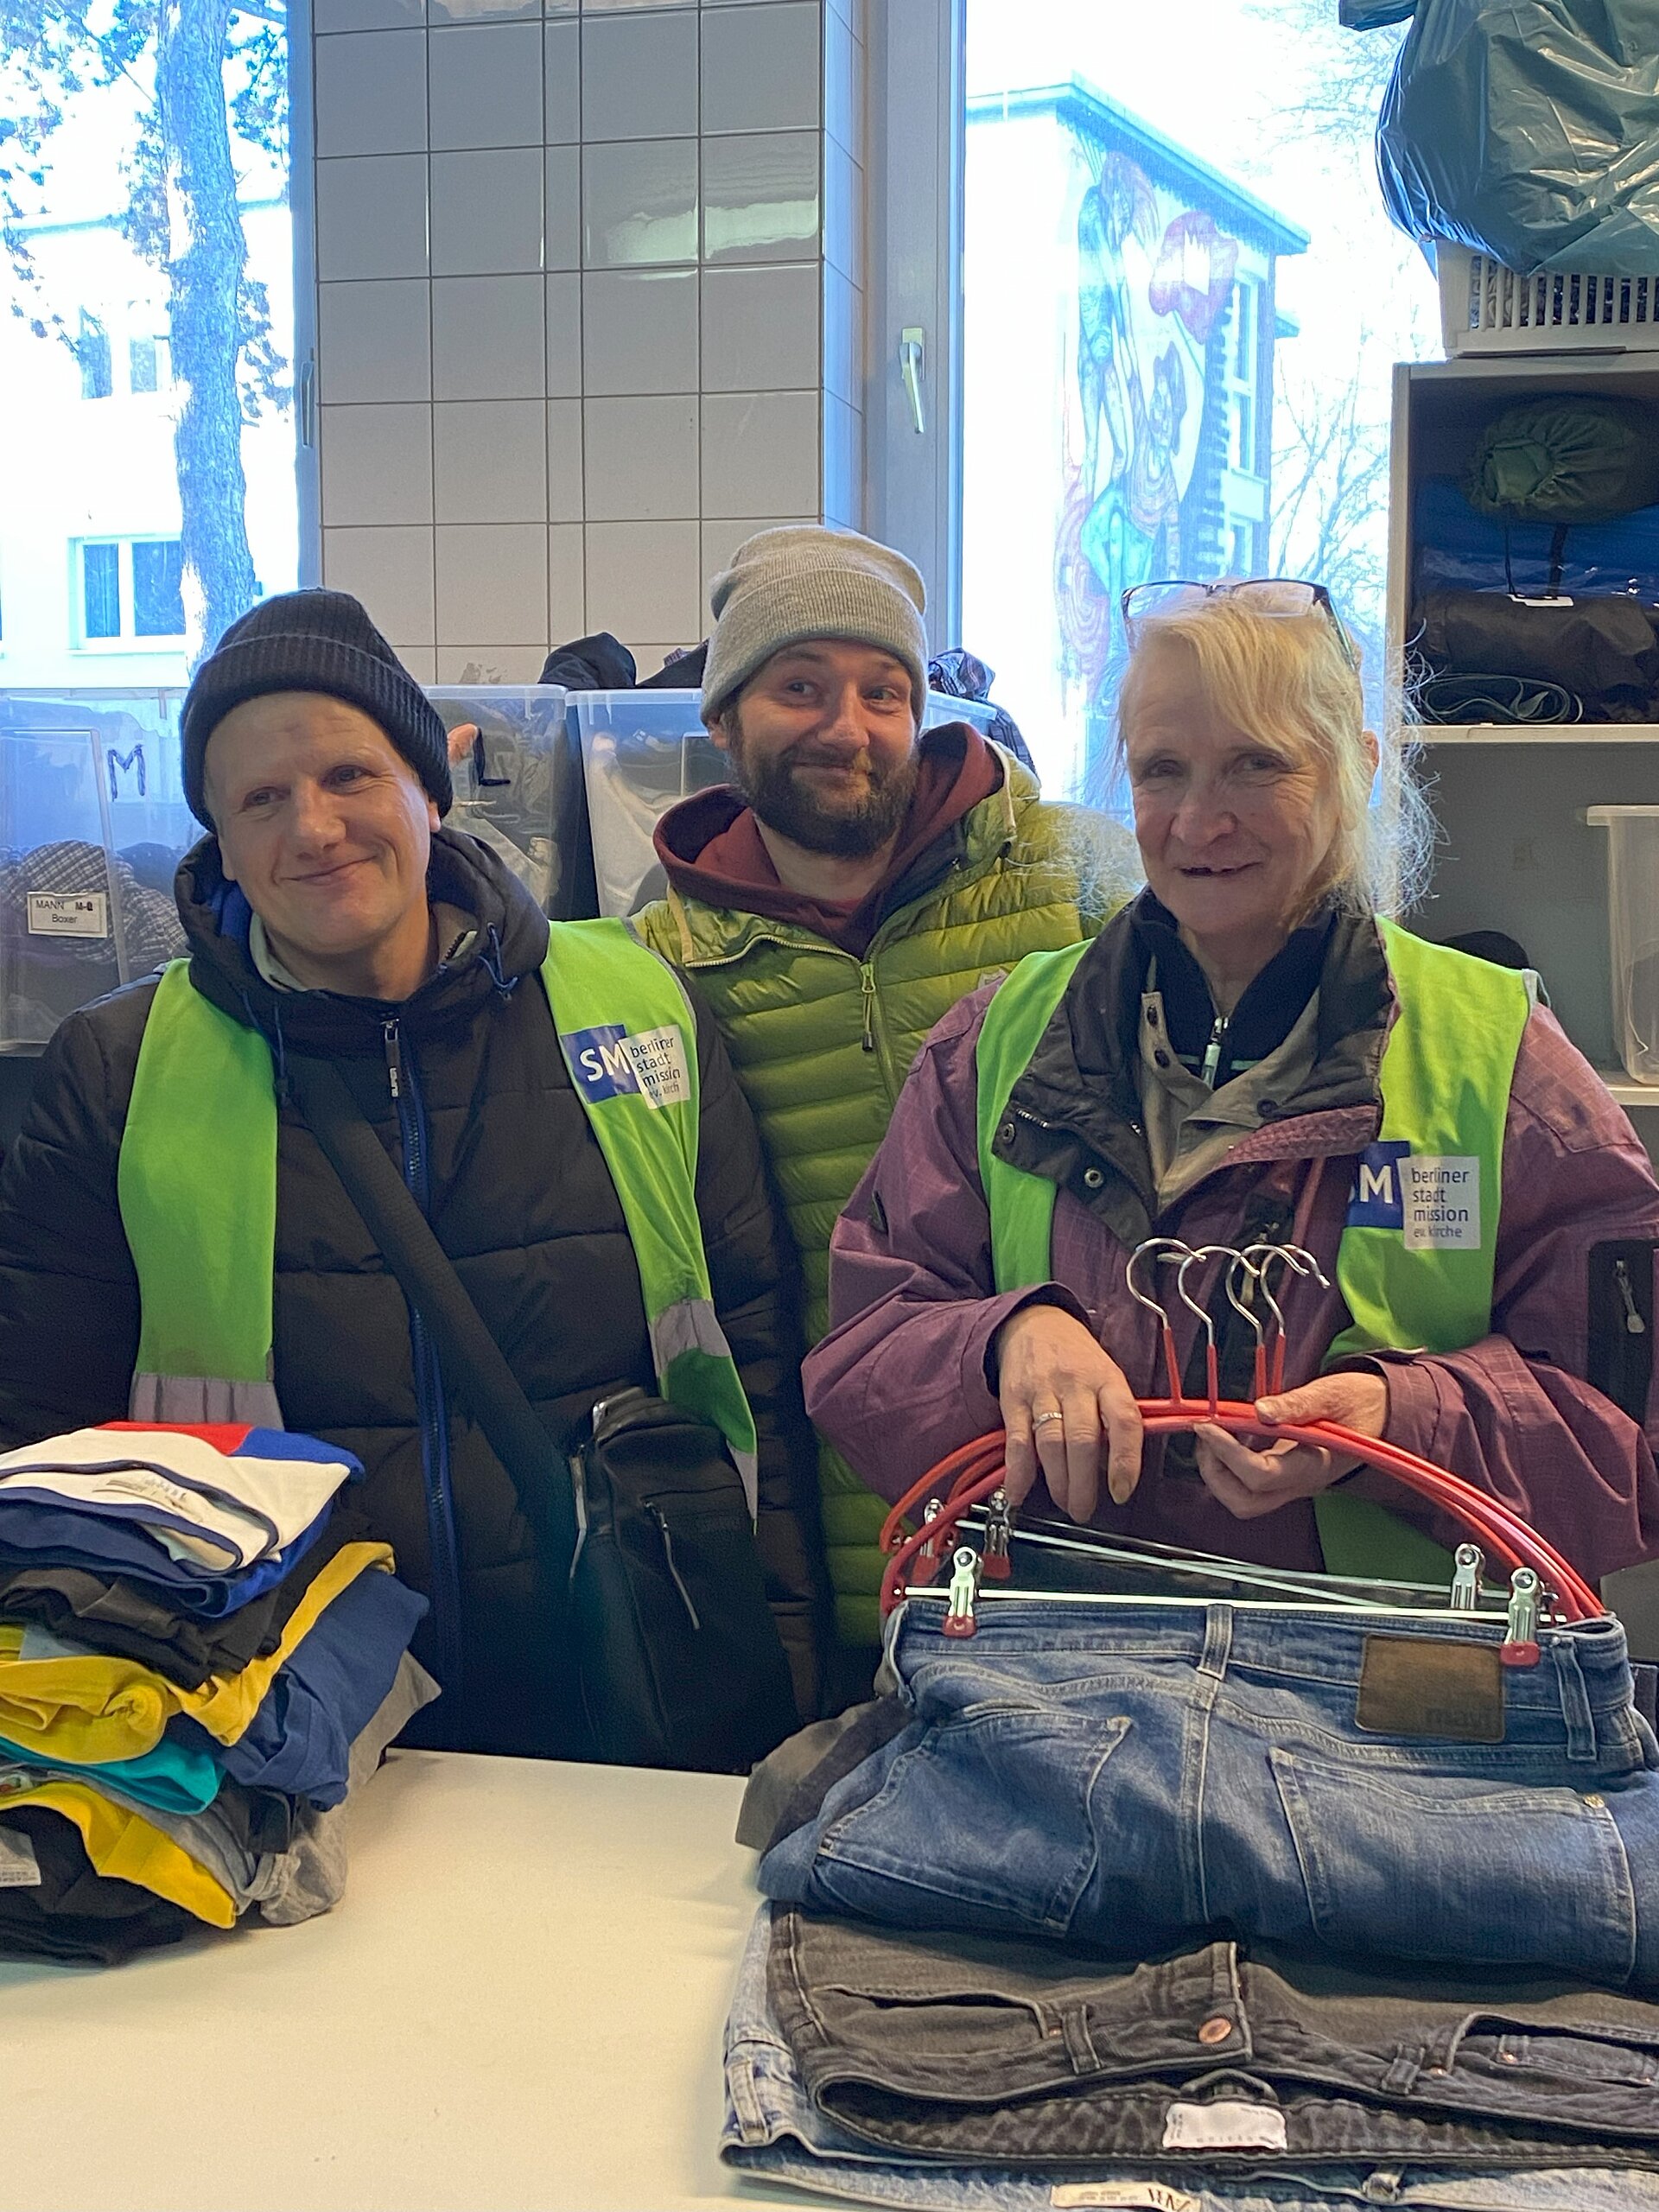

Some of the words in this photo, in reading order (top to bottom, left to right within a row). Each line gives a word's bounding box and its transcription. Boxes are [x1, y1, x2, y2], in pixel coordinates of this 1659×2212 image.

[473, 728, 511, 786] L
[107, 744, 145, 802] M
[35, 899, 65, 911] MANN
[52, 913, 79, 924] Boxer
[630, 1037, 674, 1058] berliner
[580, 1043, 631, 1082] SM
[636, 1052, 671, 1072] stadt
[1348, 1163, 1394, 1204] M
[1411, 1167, 1471, 1184] berliner
[1413, 1186, 1448, 1203] stadt
[1414, 1205, 1469, 1222] mission
[1428, 1224, 1463, 1238] kirche
